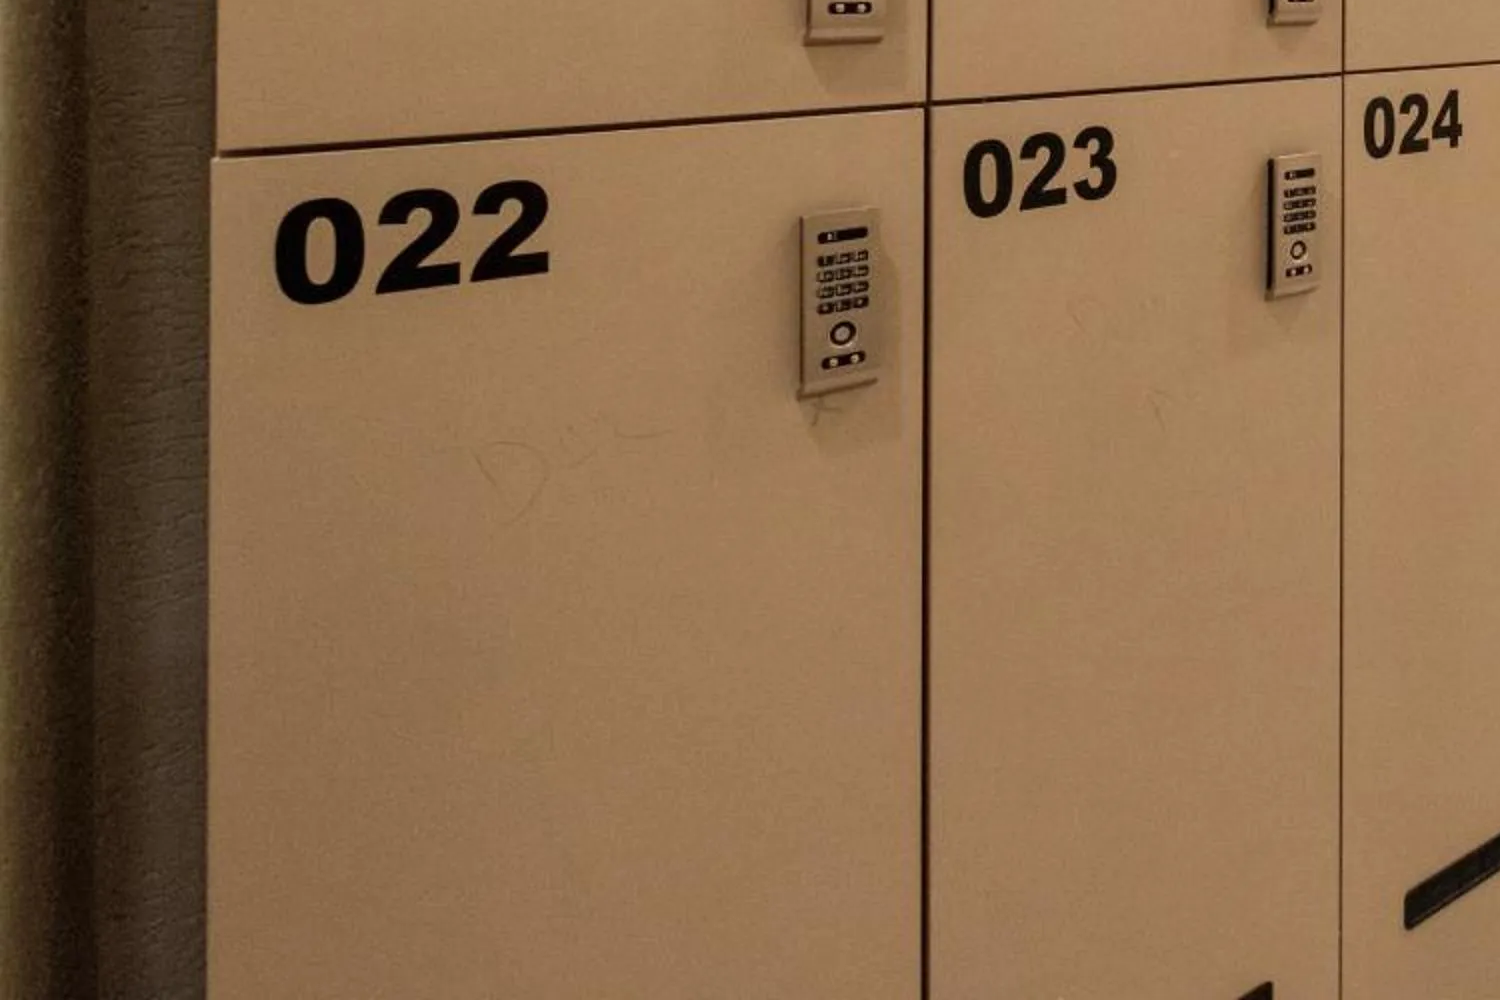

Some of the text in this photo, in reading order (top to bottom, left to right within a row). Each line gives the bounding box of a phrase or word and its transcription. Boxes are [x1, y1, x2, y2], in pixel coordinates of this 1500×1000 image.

[1364, 88, 1463, 160] 024
[963, 125, 1118, 219] 023
[274, 179, 550, 306] 022
